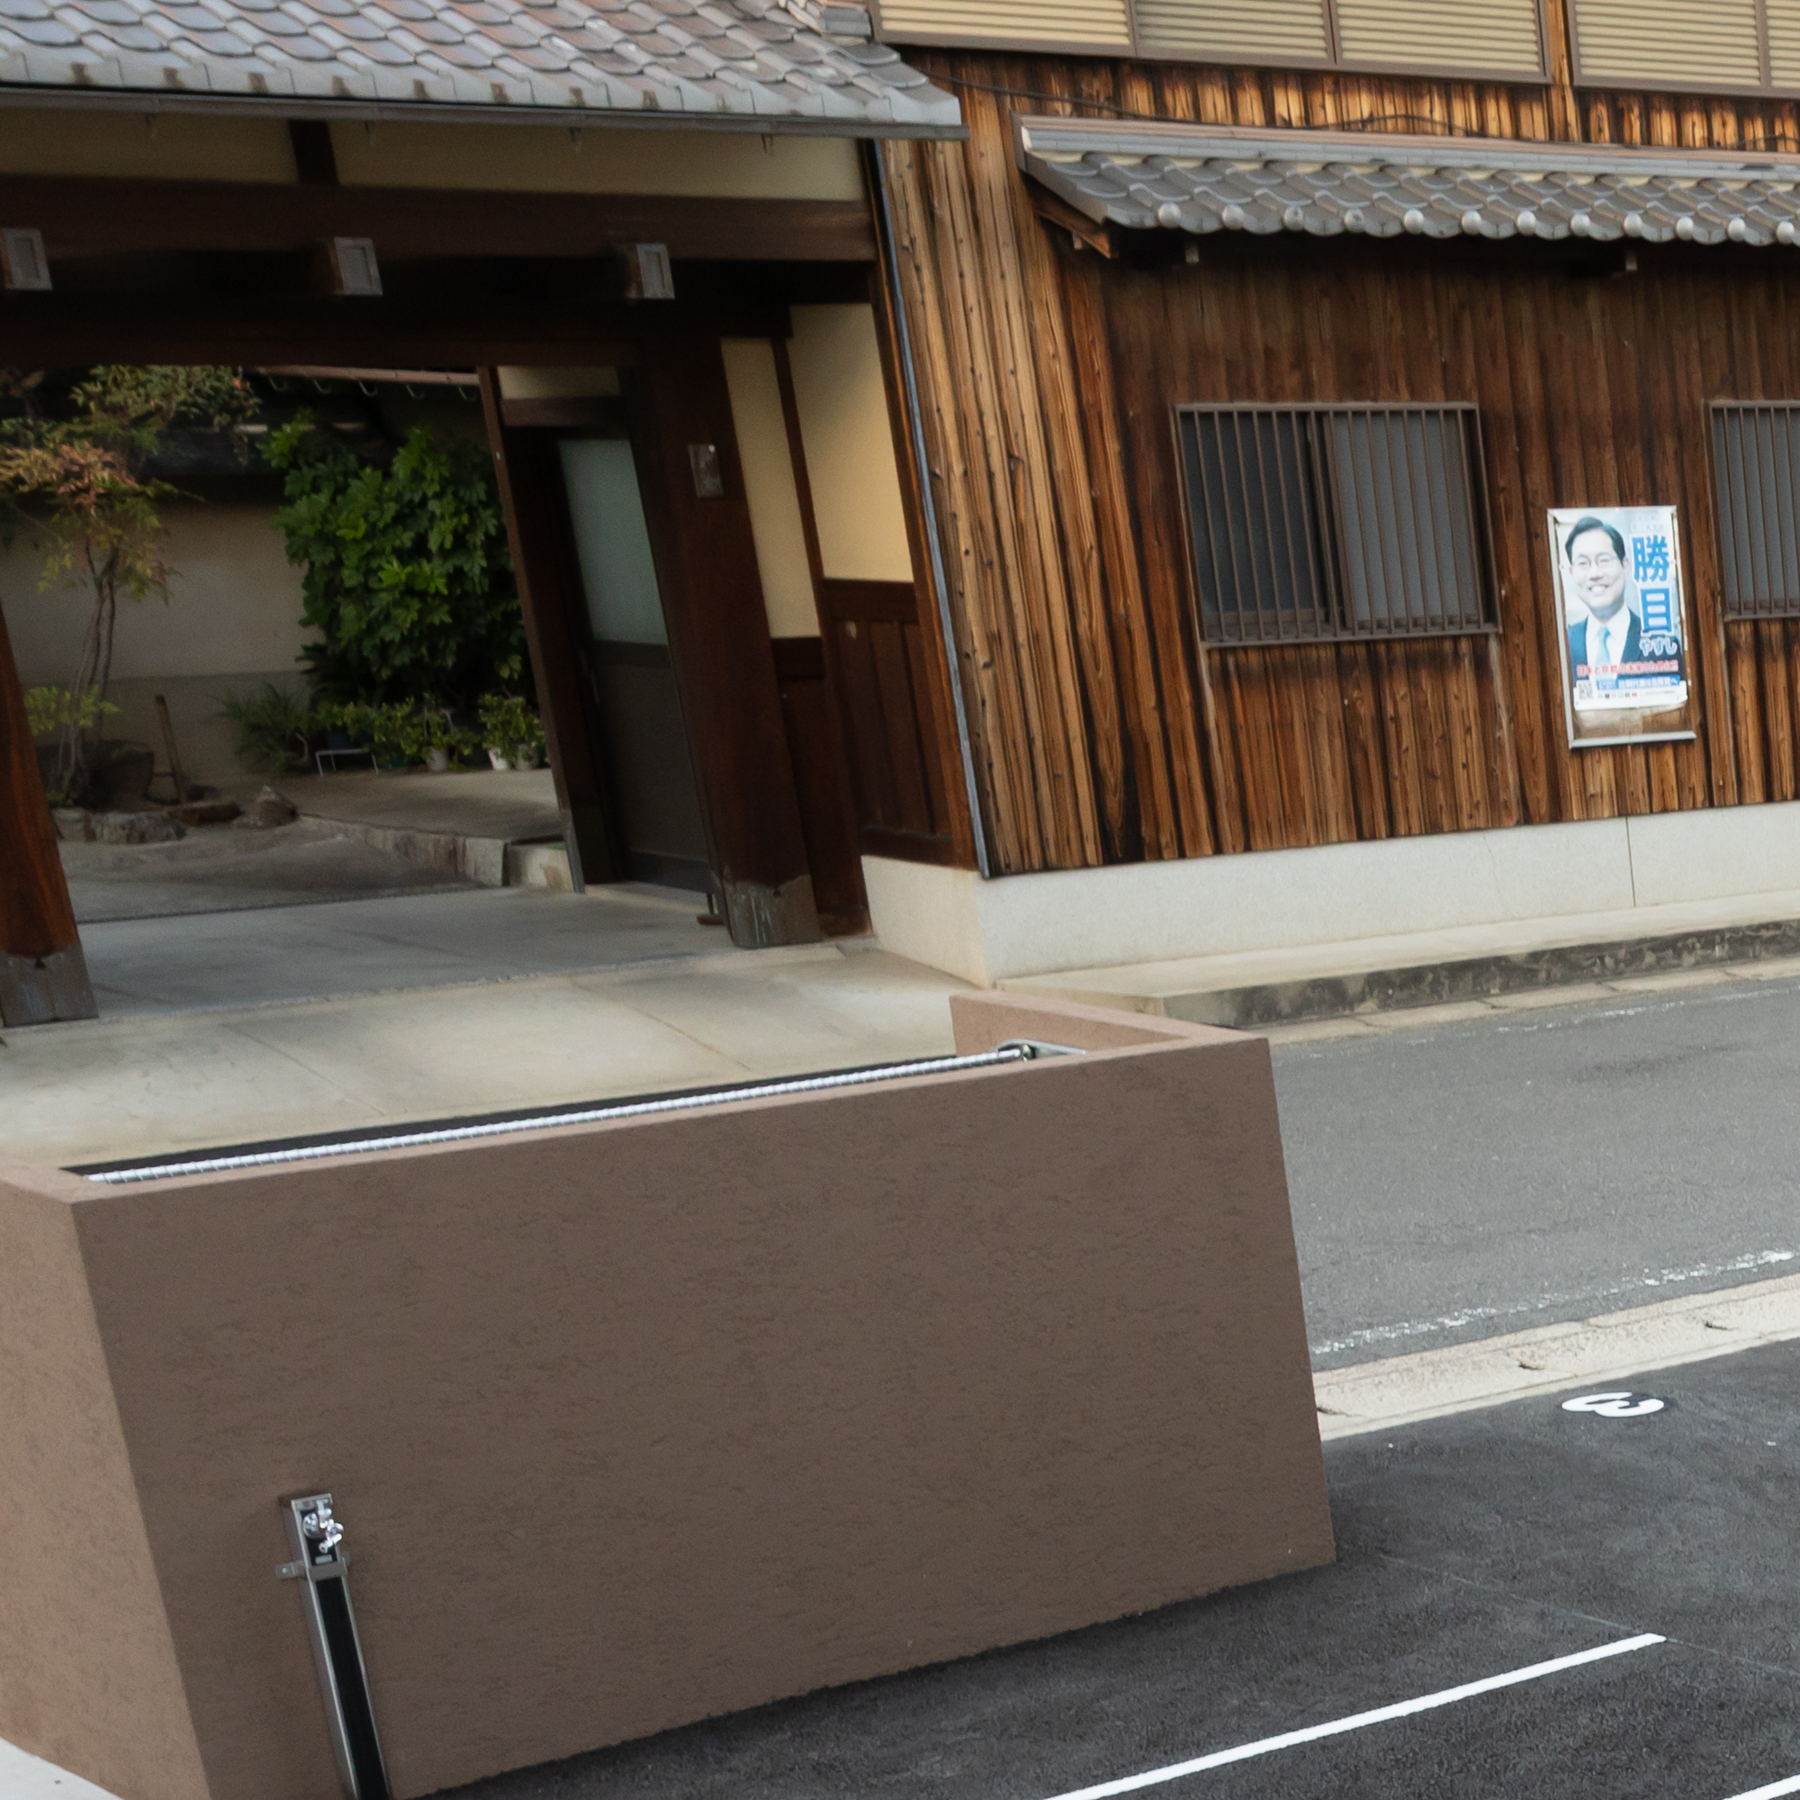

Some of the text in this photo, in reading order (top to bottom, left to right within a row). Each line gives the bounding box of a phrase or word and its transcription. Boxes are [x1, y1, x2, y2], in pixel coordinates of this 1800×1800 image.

[1631, 534, 1672, 633] 勝目
[1638, 635, 1678, 657] やすし
[1561, 1391, 1665, 1418] 3
